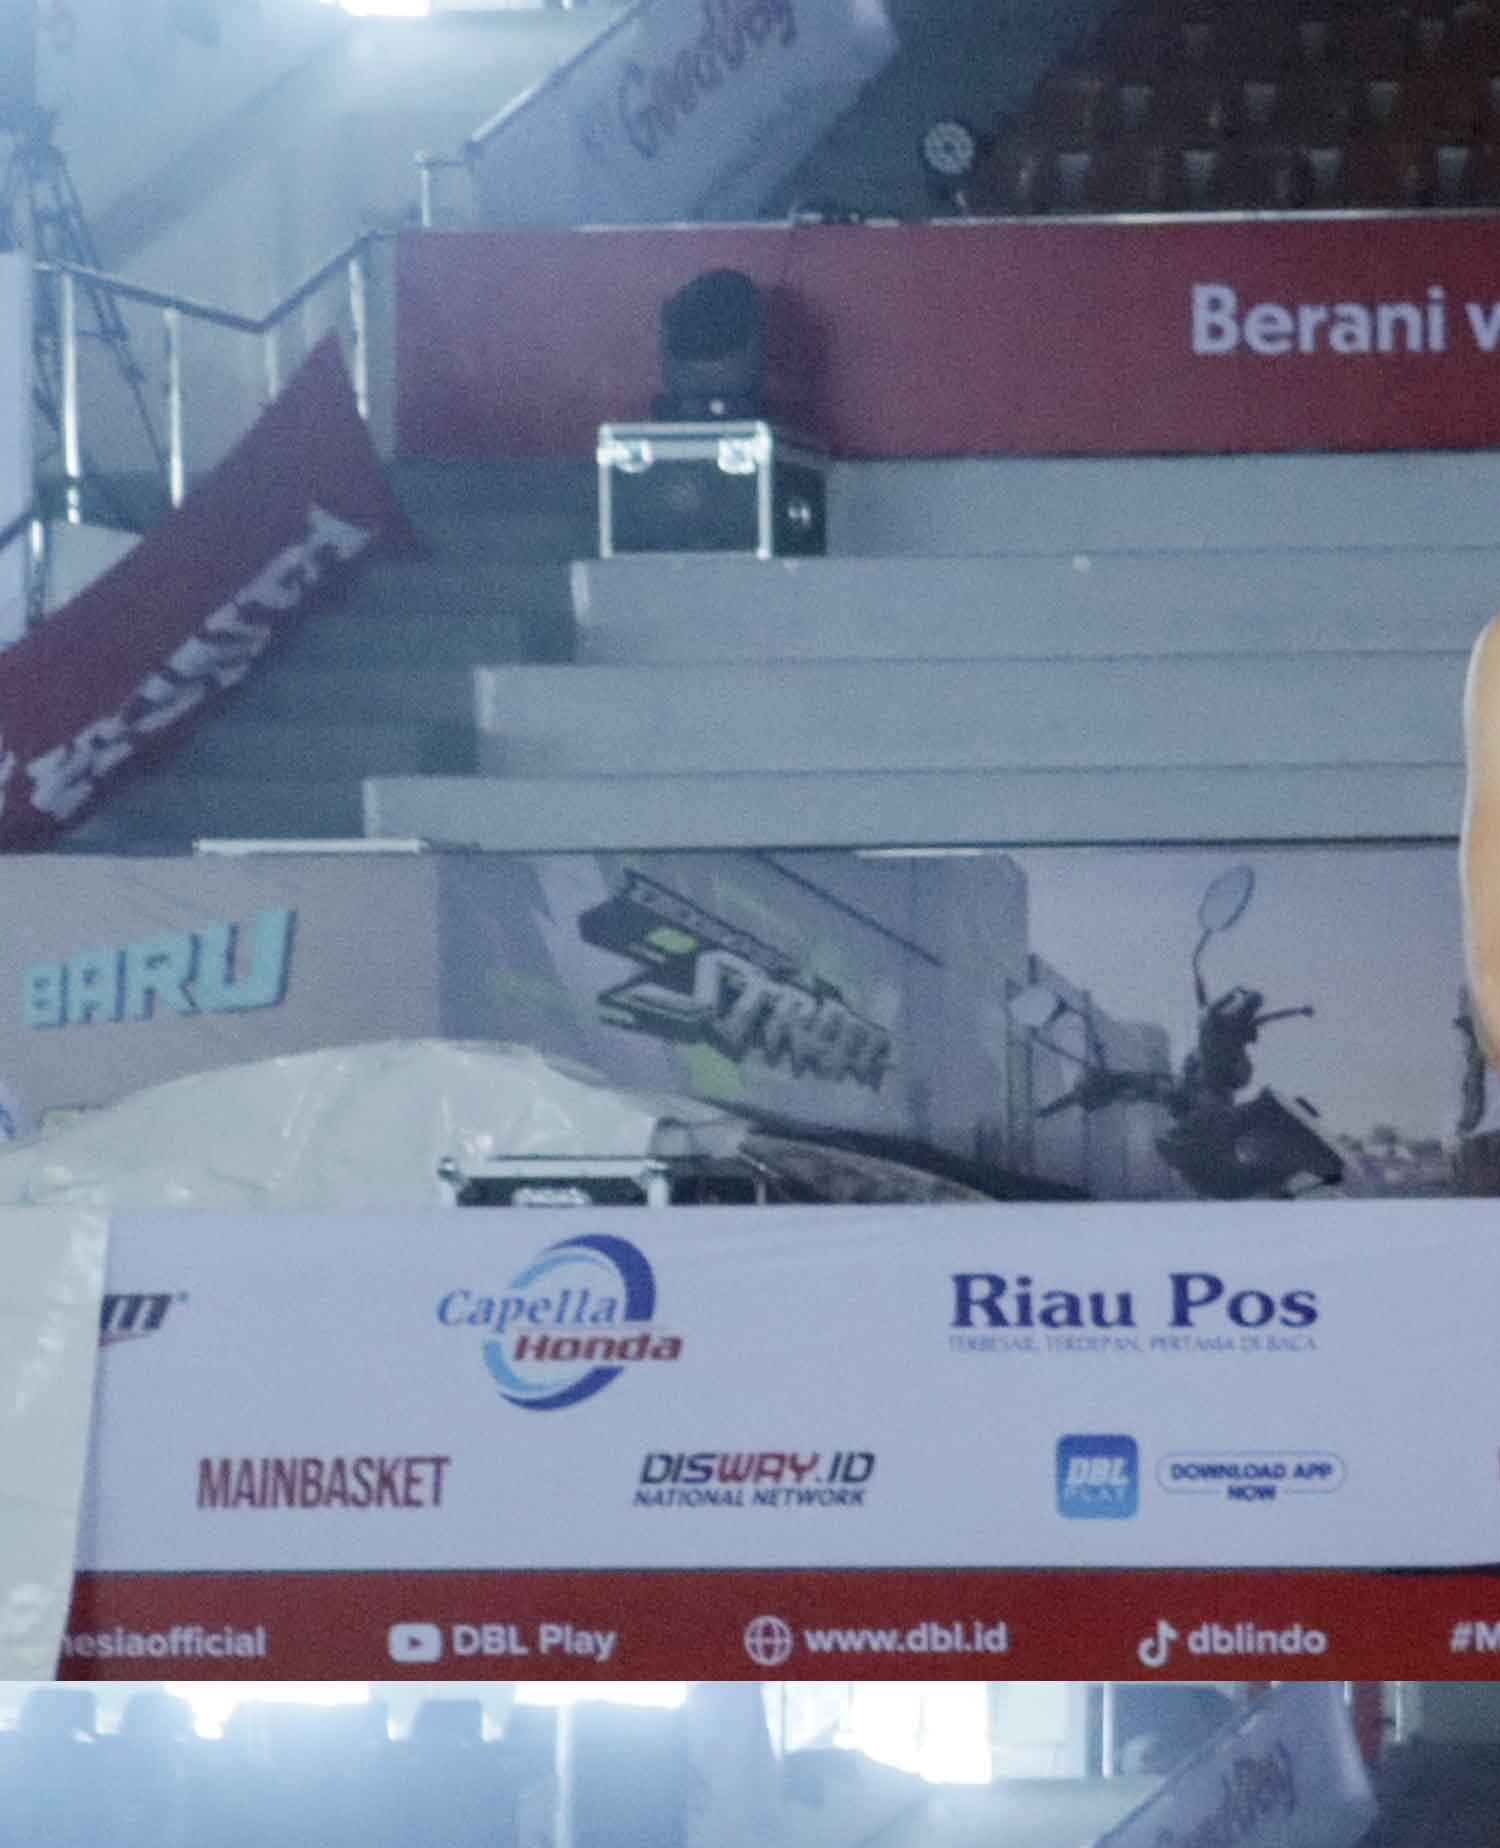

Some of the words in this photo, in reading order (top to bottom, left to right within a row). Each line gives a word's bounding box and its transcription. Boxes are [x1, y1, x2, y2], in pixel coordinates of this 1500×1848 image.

[1191, 284, 1447, 354] Berani
[437, 1287, 628, 1333] Capella
[950, 1272, 1136, 1329] Riau
[1169, 1272, 1320, 1329] Pos
[513, 1332, 683, 1362] Honda
[198, 1455, 451, 1510] MAINBASKET
[639, 1451, 876, 1484] DISWAY.ID
[1170, 1463, 1287, 1481] DOWNLOAD
[1292, 1463, 1333, 1481] APP
[632, 1487, 745, 1508] NATIONAL
[753, 1487, 866, 1508] NETWORK
[1227, 1484, 1276, 1500] NOW
[453, 1625, 532, 1656] DBL
[540, 1625, 618, 1661] Play
[805, 1621, 1007, 1654] www.dbl.id
[1188, 1621, 1327, 1655] dblindo
